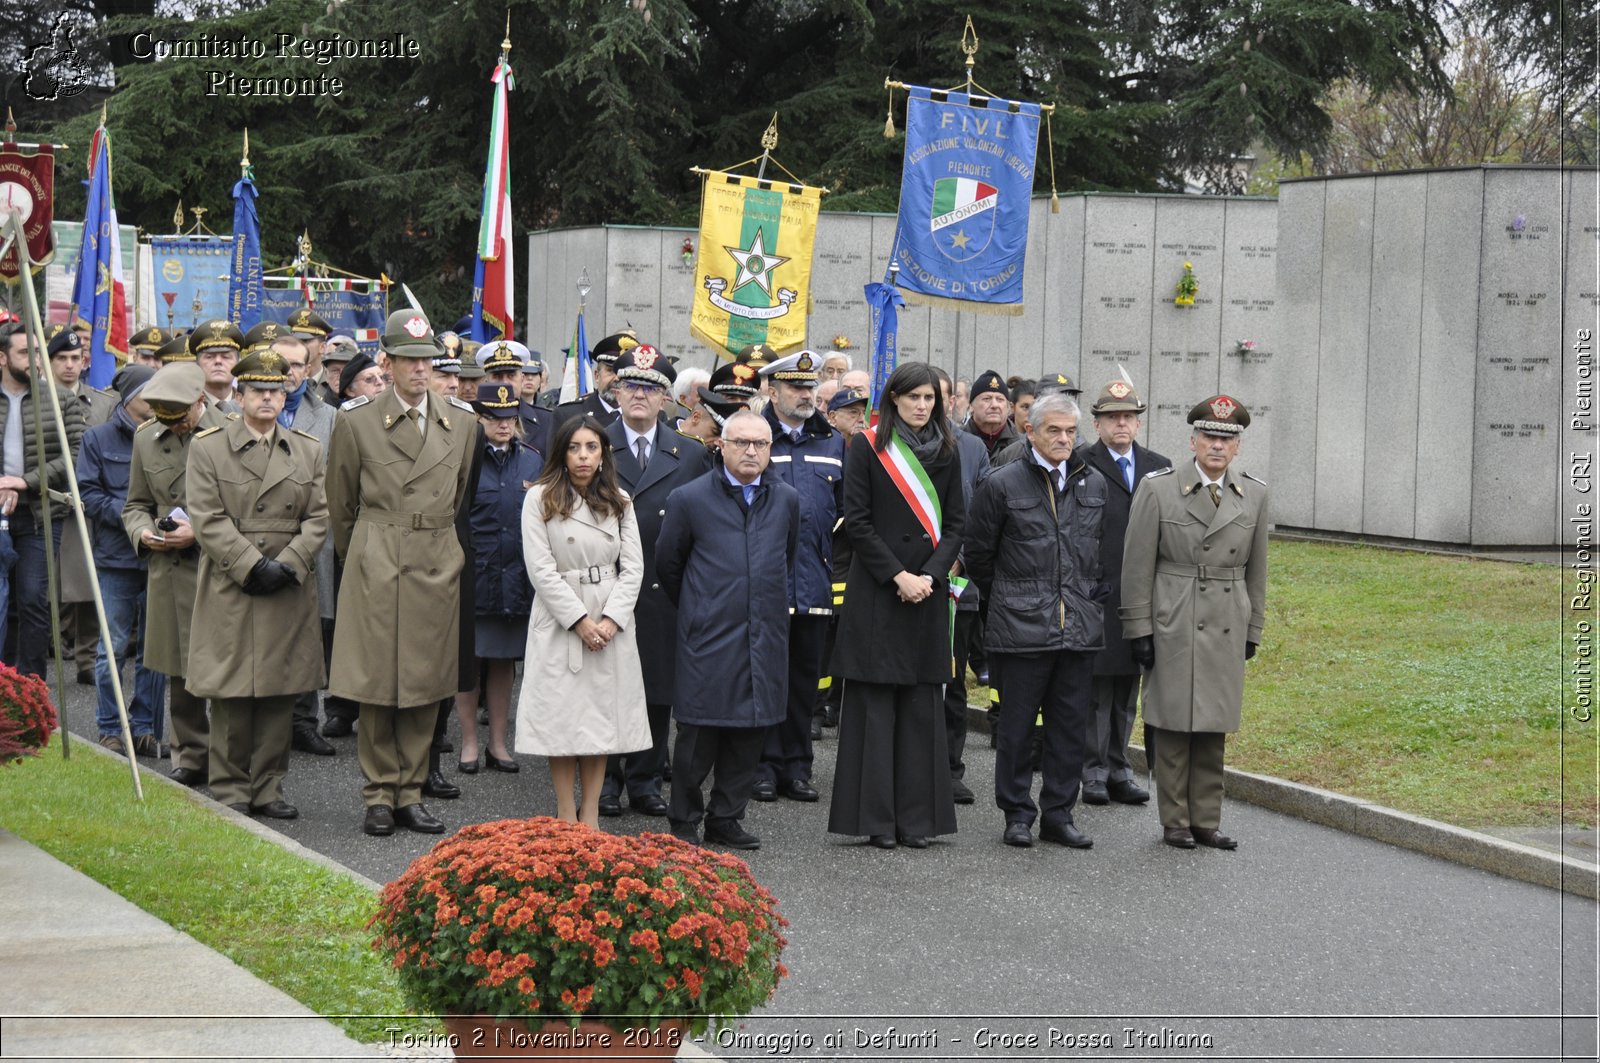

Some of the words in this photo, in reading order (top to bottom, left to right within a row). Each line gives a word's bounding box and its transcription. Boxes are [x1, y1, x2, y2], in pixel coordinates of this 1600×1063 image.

[909, 137, 960, 165] ASSOCIAZIONE
[964, 136, 1005, 158] VOLONTARI
[948, 161, 992, 177] PIEMONTE
[933, 199, 991, 228] AUTONOMI
[236, 233, 246, 274] Piemonte
[899, 248, 947, 291] SEZIONE
[951, 282, 965, 293] DI
[970, 264, 1016, 293] TORINO
[747, 309, 758, 317] DEL
